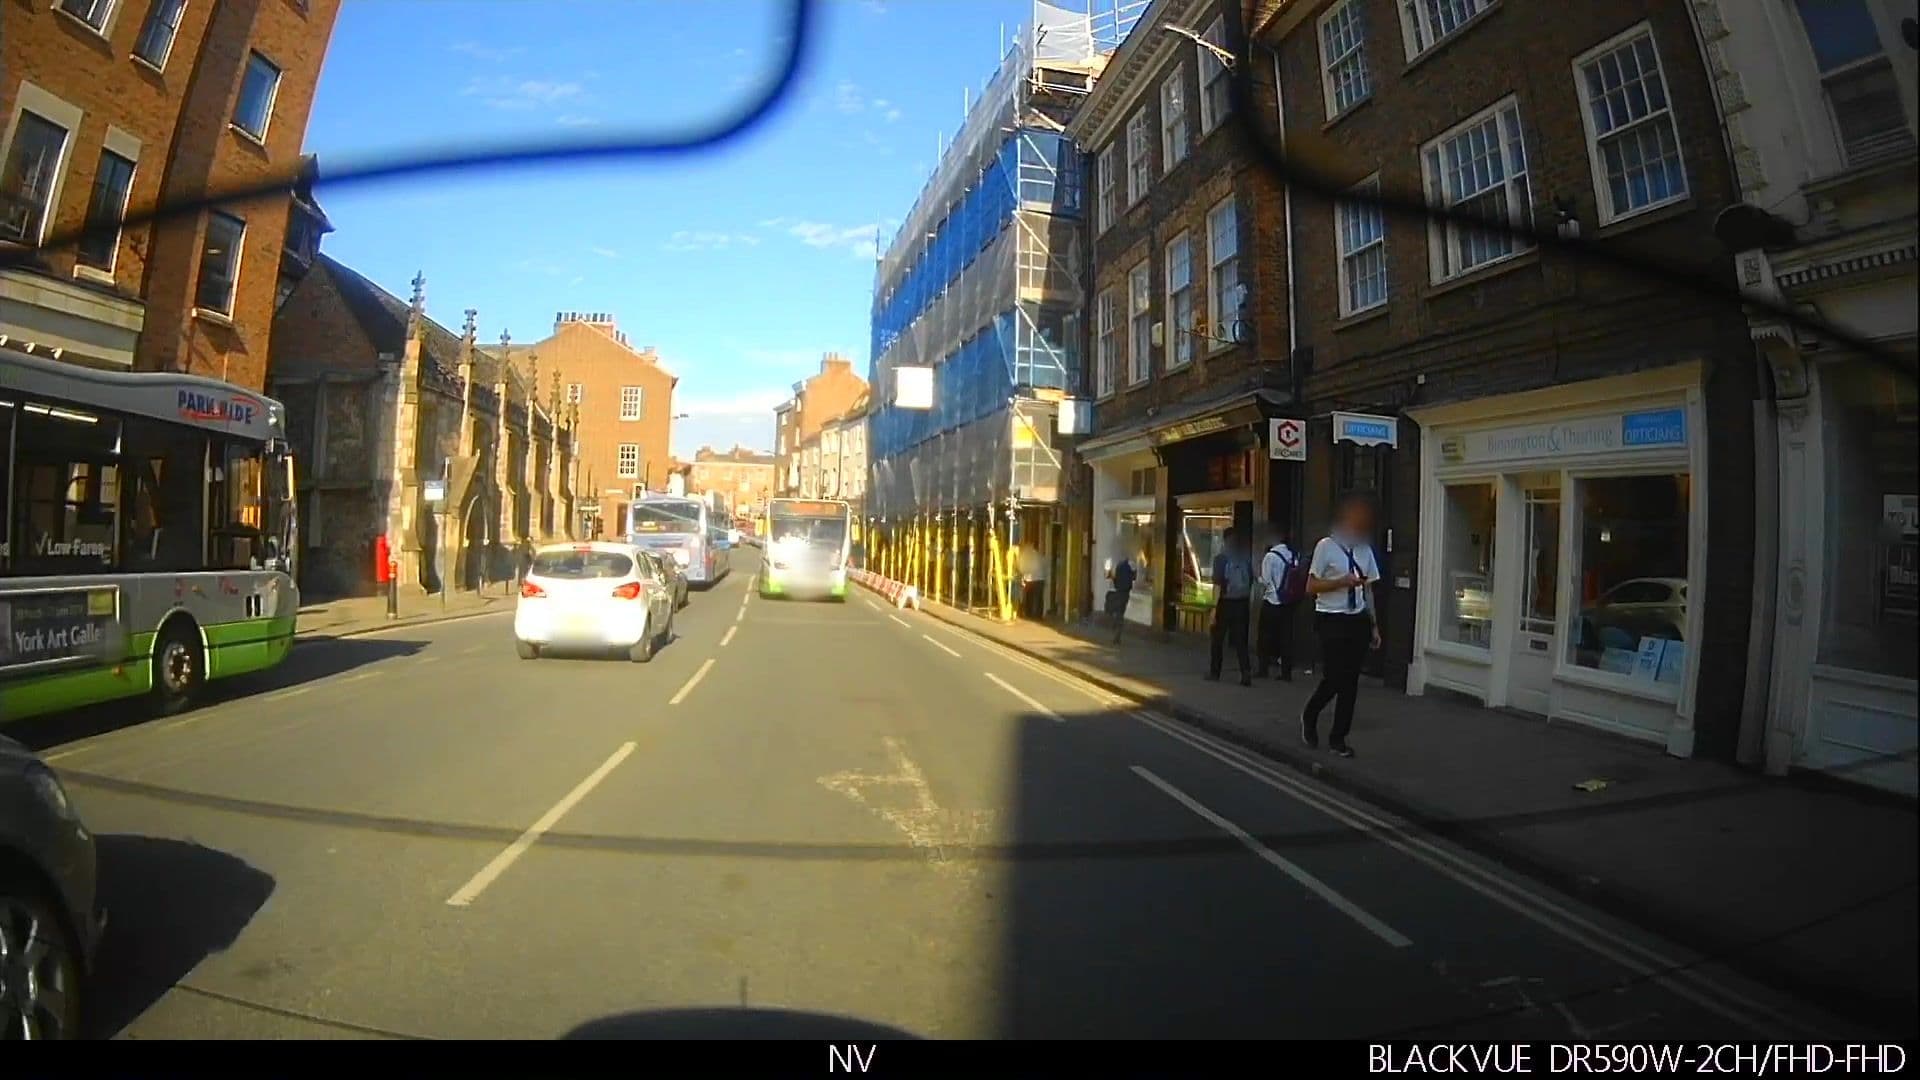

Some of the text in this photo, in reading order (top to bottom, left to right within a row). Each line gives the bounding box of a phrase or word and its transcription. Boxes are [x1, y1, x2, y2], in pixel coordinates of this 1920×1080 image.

[47, 538, 71, 556] Low
[15, 627, 45, 655] York
[47, 628, 68, 650] Art
